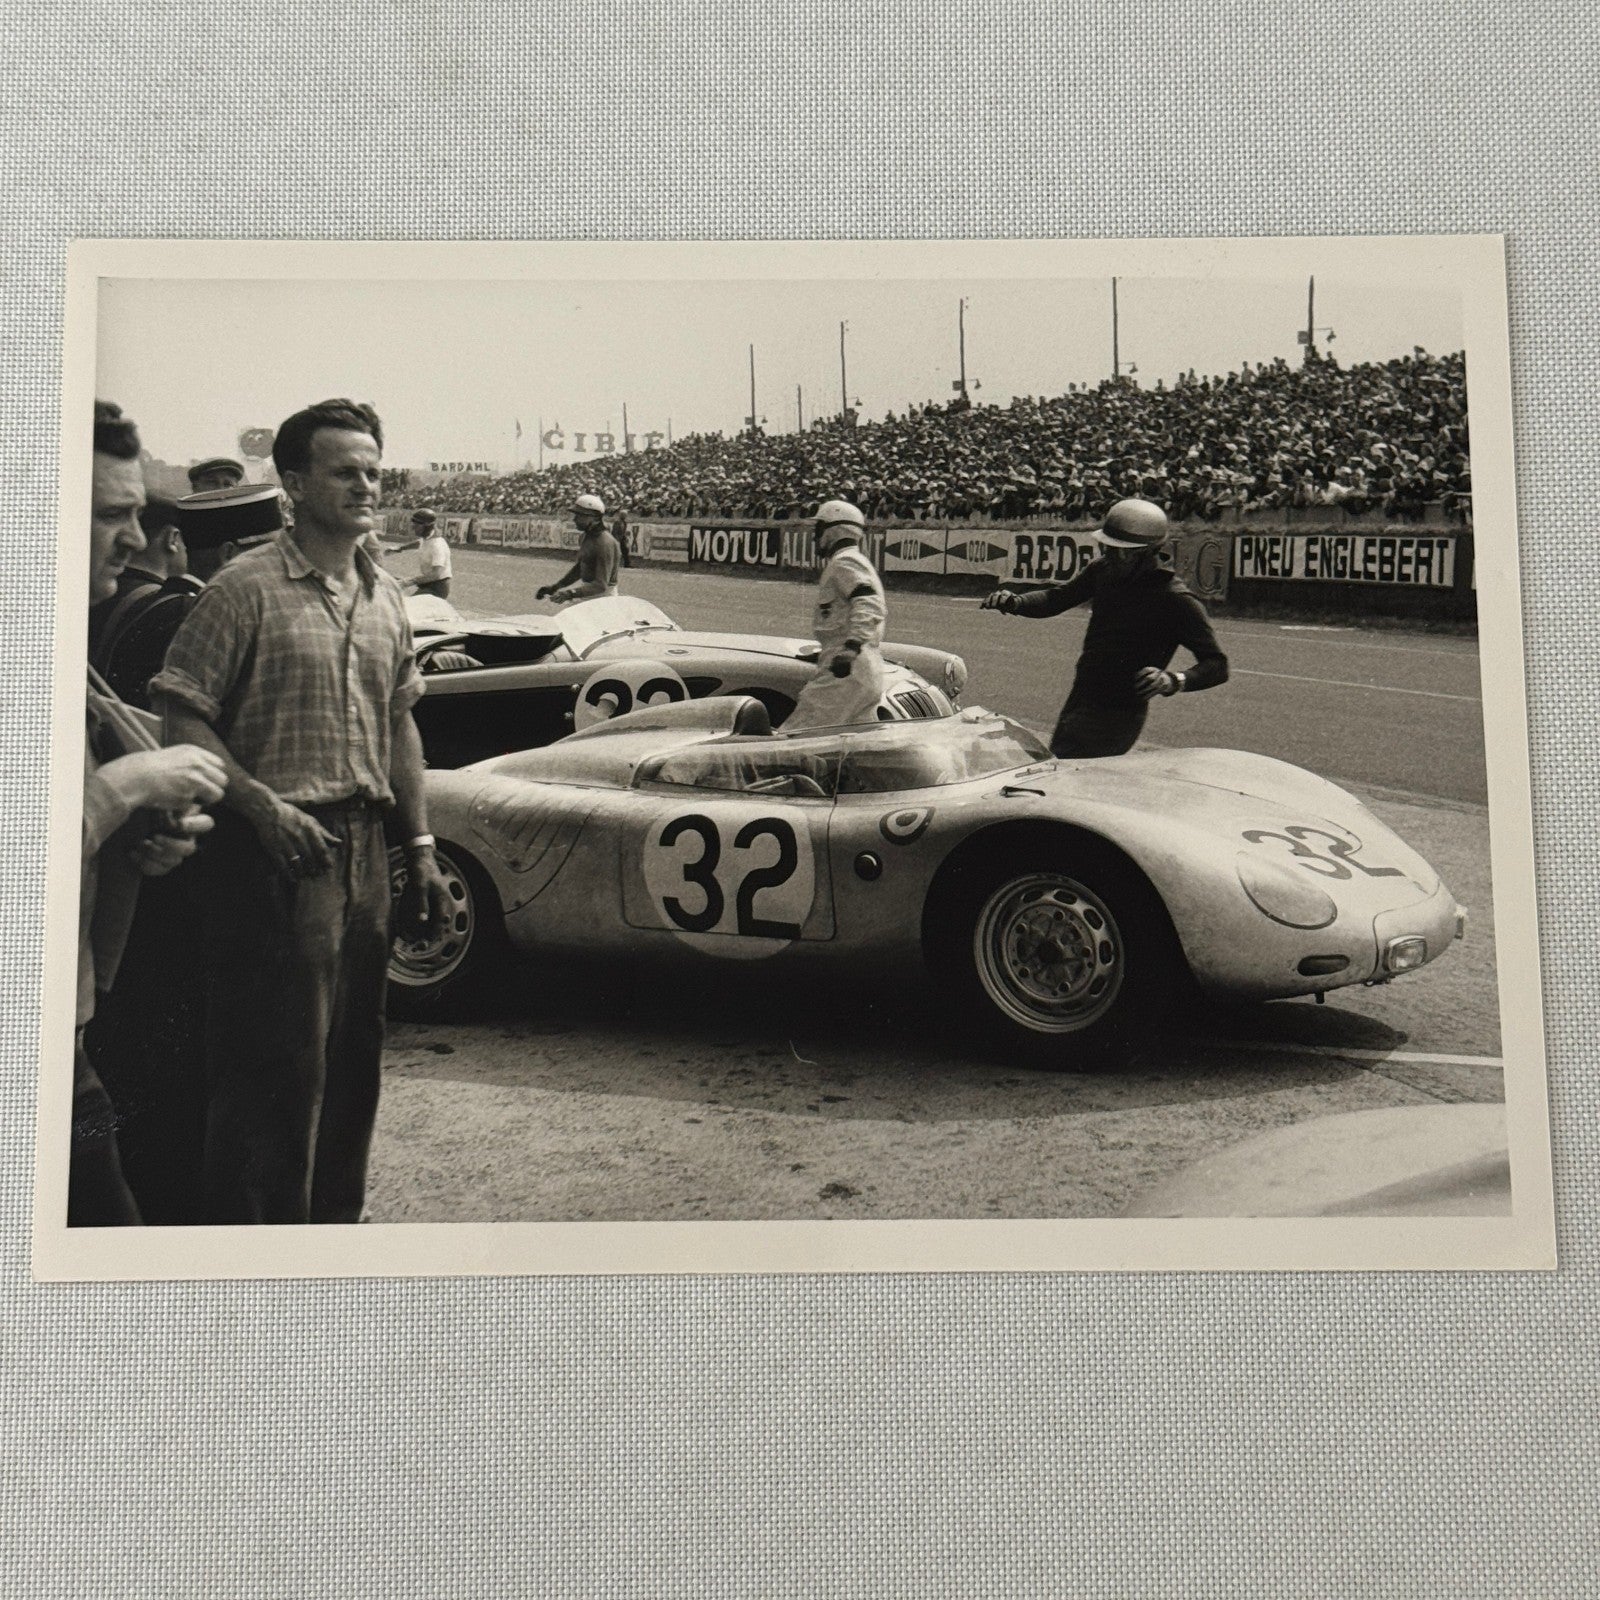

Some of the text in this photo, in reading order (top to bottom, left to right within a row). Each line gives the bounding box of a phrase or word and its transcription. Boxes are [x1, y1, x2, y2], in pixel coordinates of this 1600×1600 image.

[431, 462, 490, 472] BARDAHL
[692, 530, 778, 565] MOTUL
[1240, 537, 1294, 577] PNEU
[1304, 538, 1449, 584] ENGLEBERT
[1242, 825, 1406, 880] 32
[659, 814, 801, 939] 32
